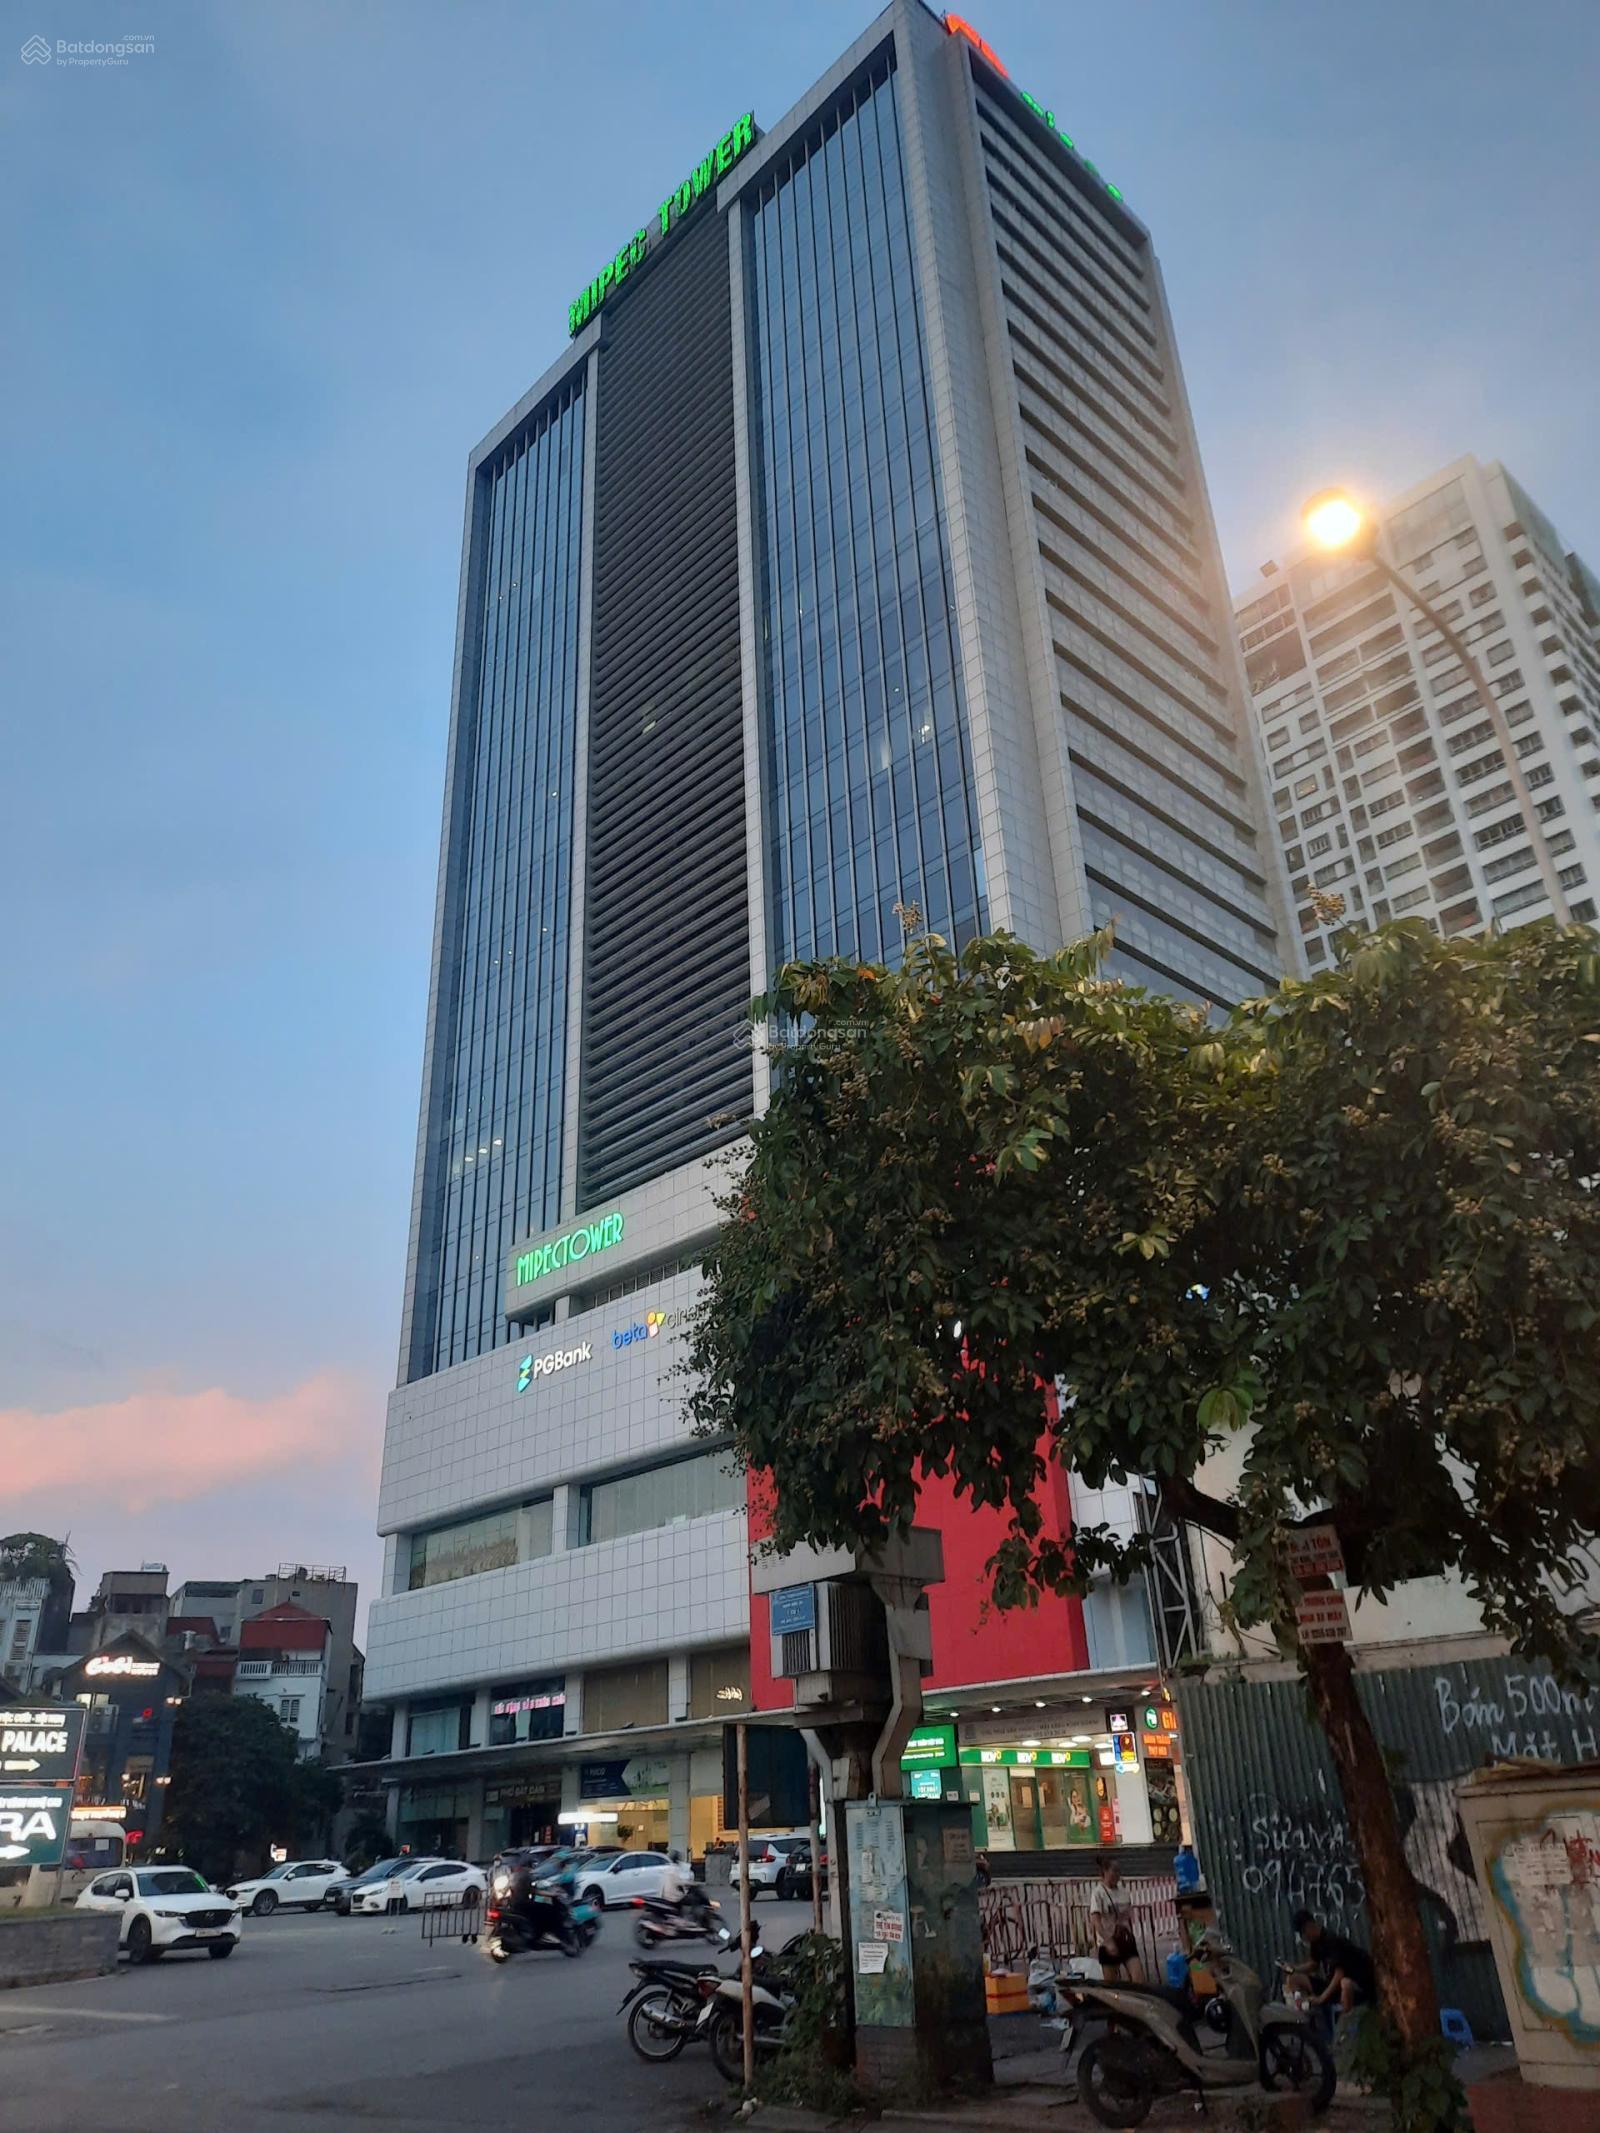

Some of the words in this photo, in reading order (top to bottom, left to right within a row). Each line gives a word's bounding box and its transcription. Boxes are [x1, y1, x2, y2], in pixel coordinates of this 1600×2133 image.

[568, 228, 648, 337] MIPEC
[657, 112, 754, 237] TOWER
[610, 1321, 649, 1351] beta
[532, 1341, 595, 1381] PGBank
[1434, 1677, 1505, 1735] Bán
[2, 1730, 69, 1753] PALACE
